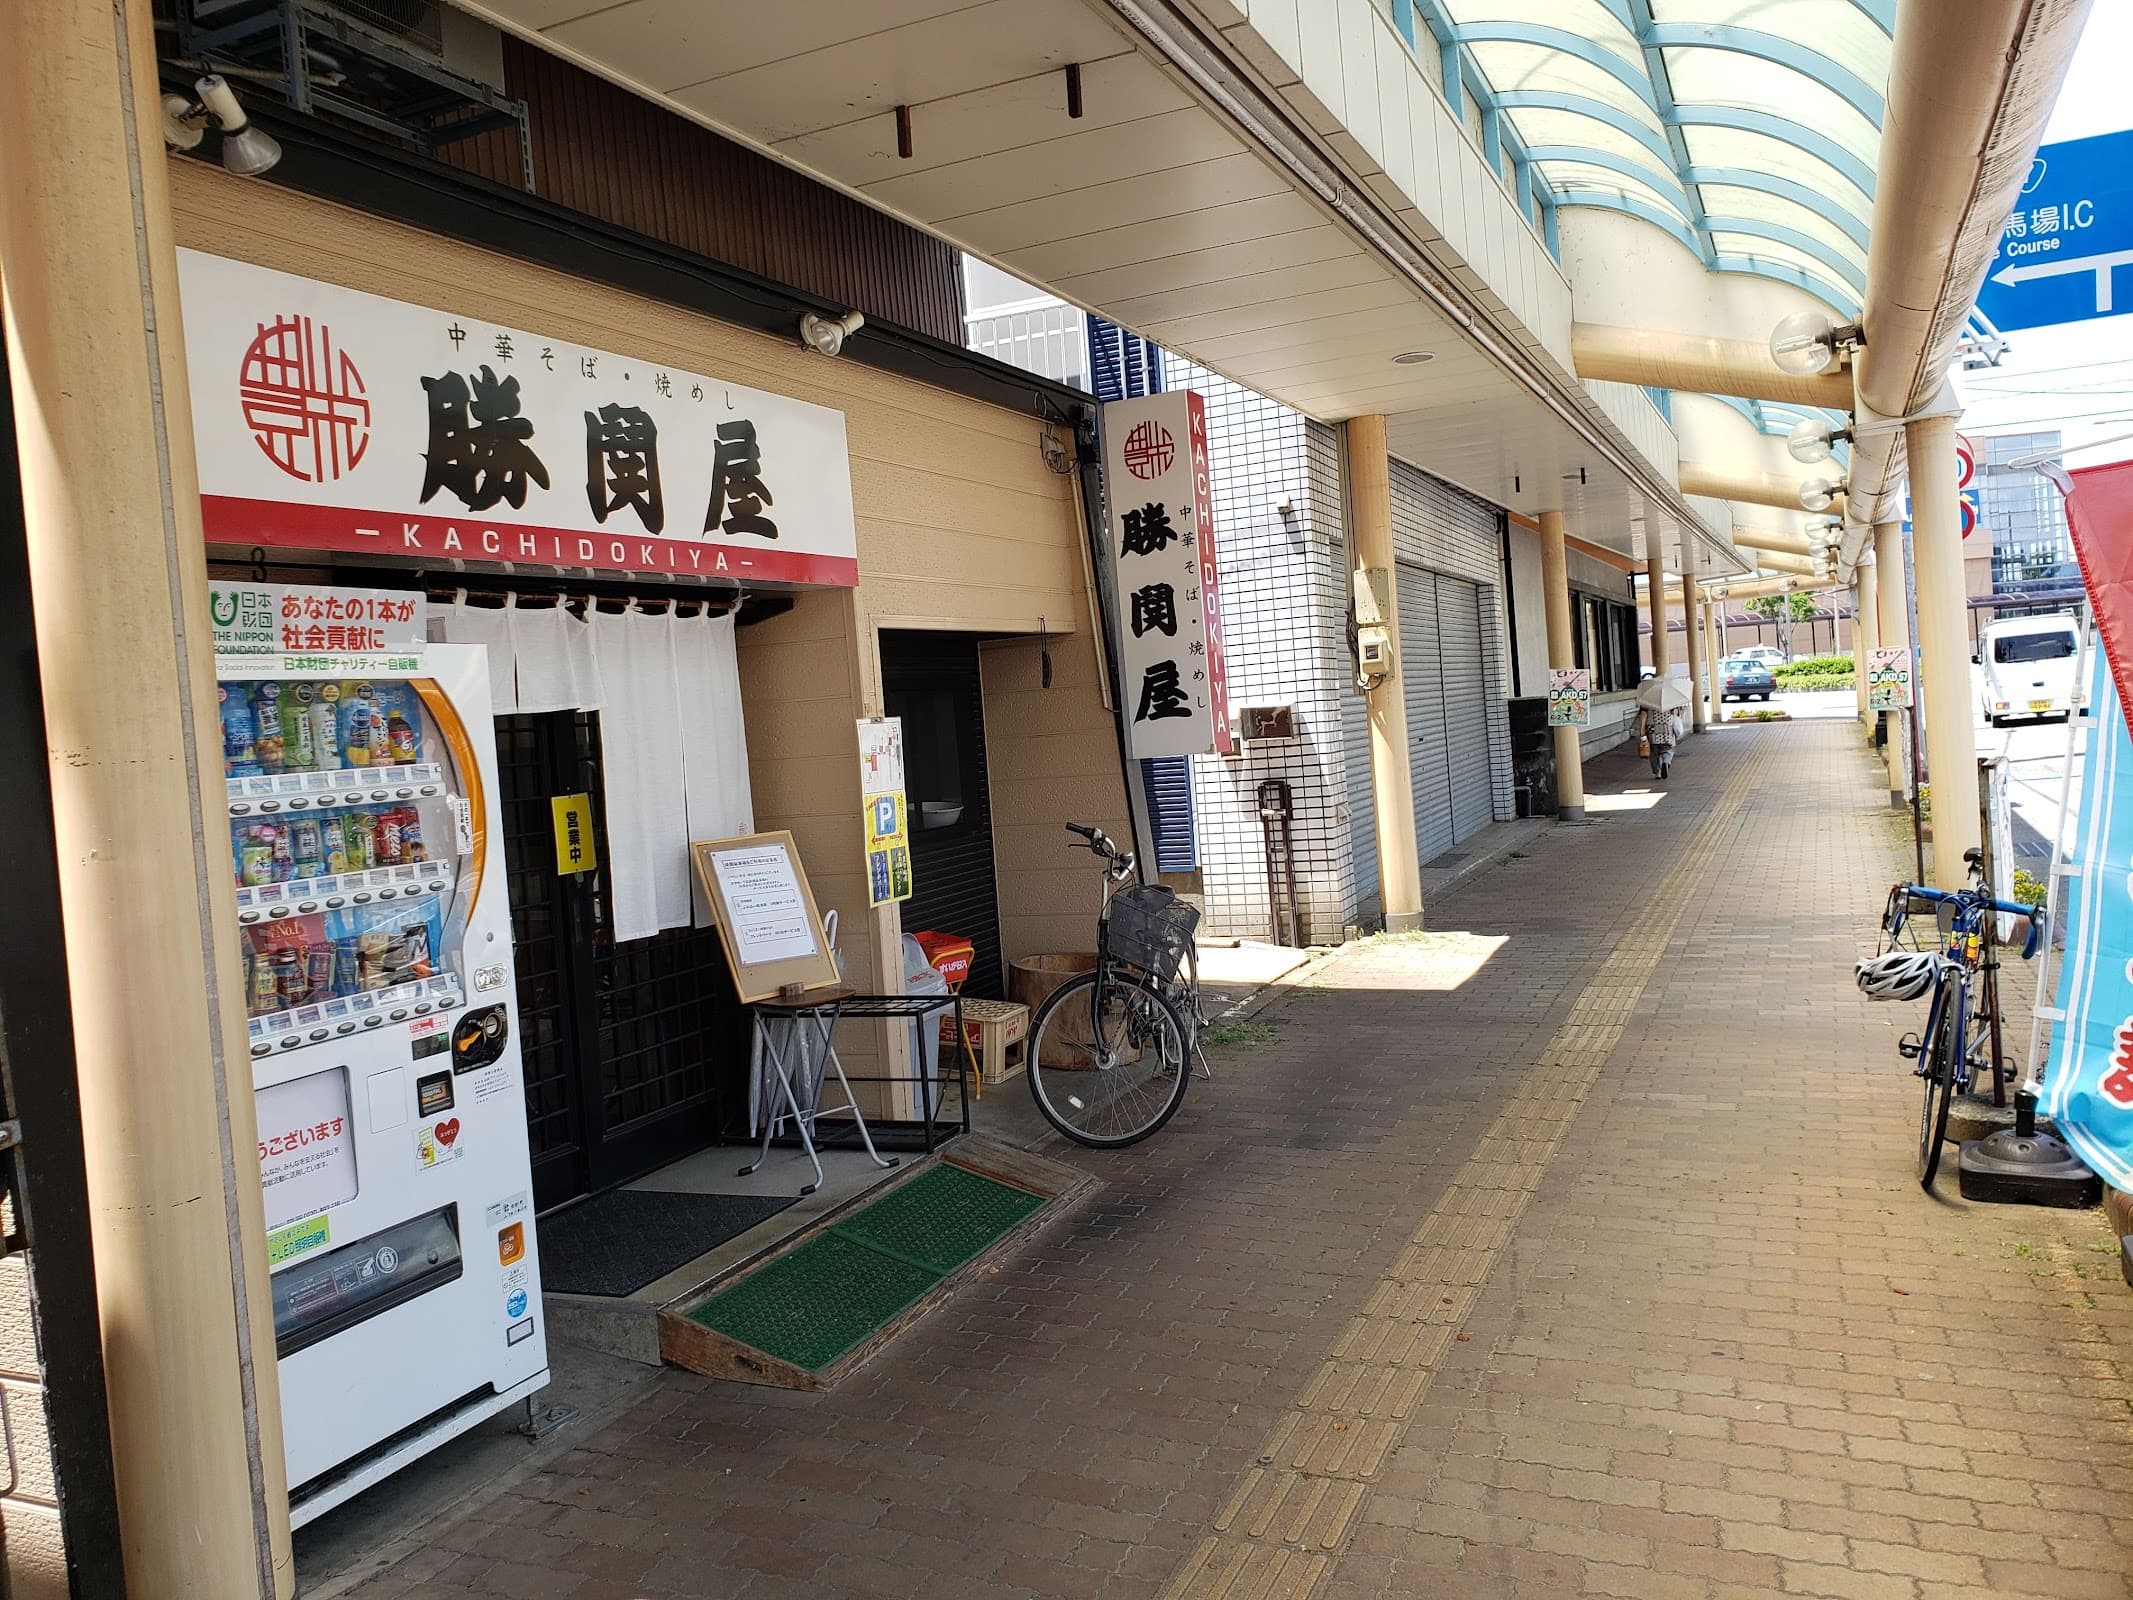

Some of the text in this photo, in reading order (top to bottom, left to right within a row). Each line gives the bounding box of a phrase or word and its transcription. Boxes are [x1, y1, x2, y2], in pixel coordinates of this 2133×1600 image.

[2007, 237, 2060, 257] Course
[447, 321, 735, 411] 中華そば・焼めし
[1191, 410, 1226, 734] KACHIDOKIYA
[241, 591, 272, 609] 日本
[281, 594, 416, 623] あなたの1本が
[1178, 504, 1207, 710] 中華そば・焼めし
[242, 611, 273, 629] 財団
[212, 631, 274, 642] THE NIPPON
[281, 623, 386, 651] 社会貢献に
[283, 656, 419, 671] 日本財団チャリティー自販機
[879, 802, 892, 831] P
[566, 810, 582, 864] 営業中
